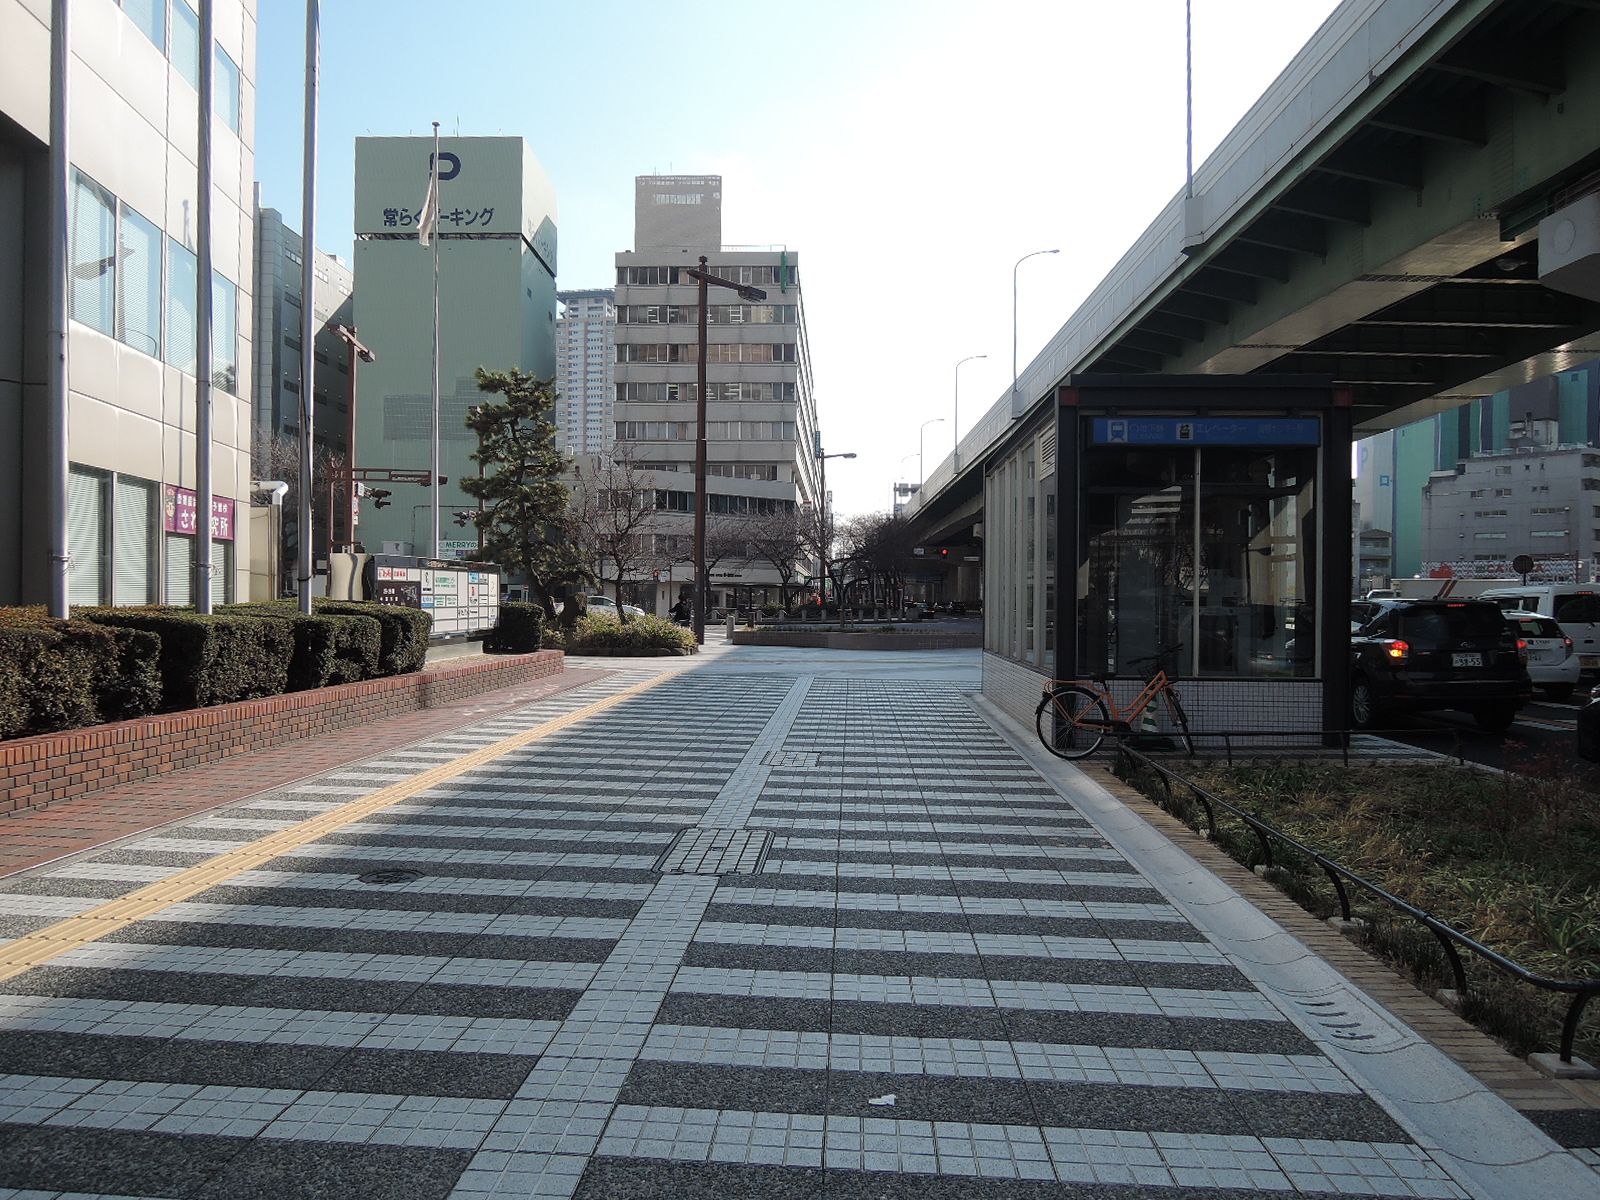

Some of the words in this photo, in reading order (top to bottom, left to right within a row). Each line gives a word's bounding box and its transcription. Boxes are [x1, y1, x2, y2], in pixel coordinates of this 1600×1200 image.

[383, 208, 494, 227] 常らくーキング
